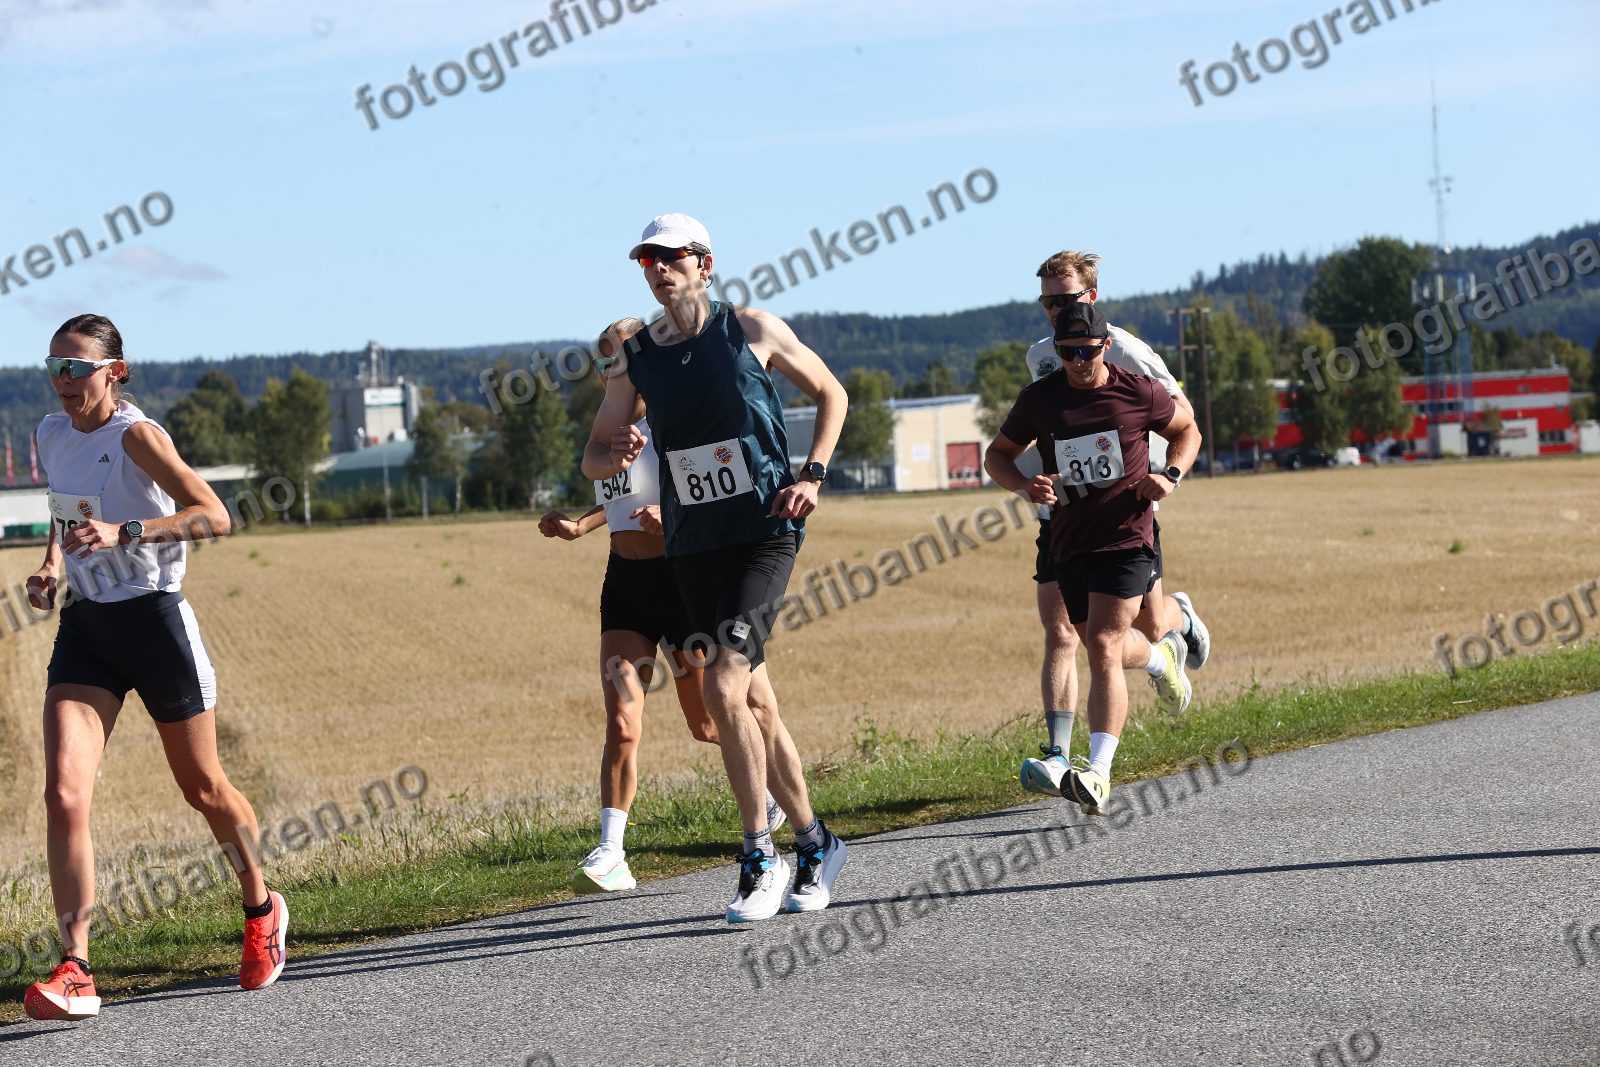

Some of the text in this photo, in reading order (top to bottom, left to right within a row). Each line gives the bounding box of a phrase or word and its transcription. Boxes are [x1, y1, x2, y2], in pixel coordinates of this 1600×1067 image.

[1069, 454, 1112, 482] 813
[601, 469, 632, 500] 542
[687, 466, 737, 502] 810
